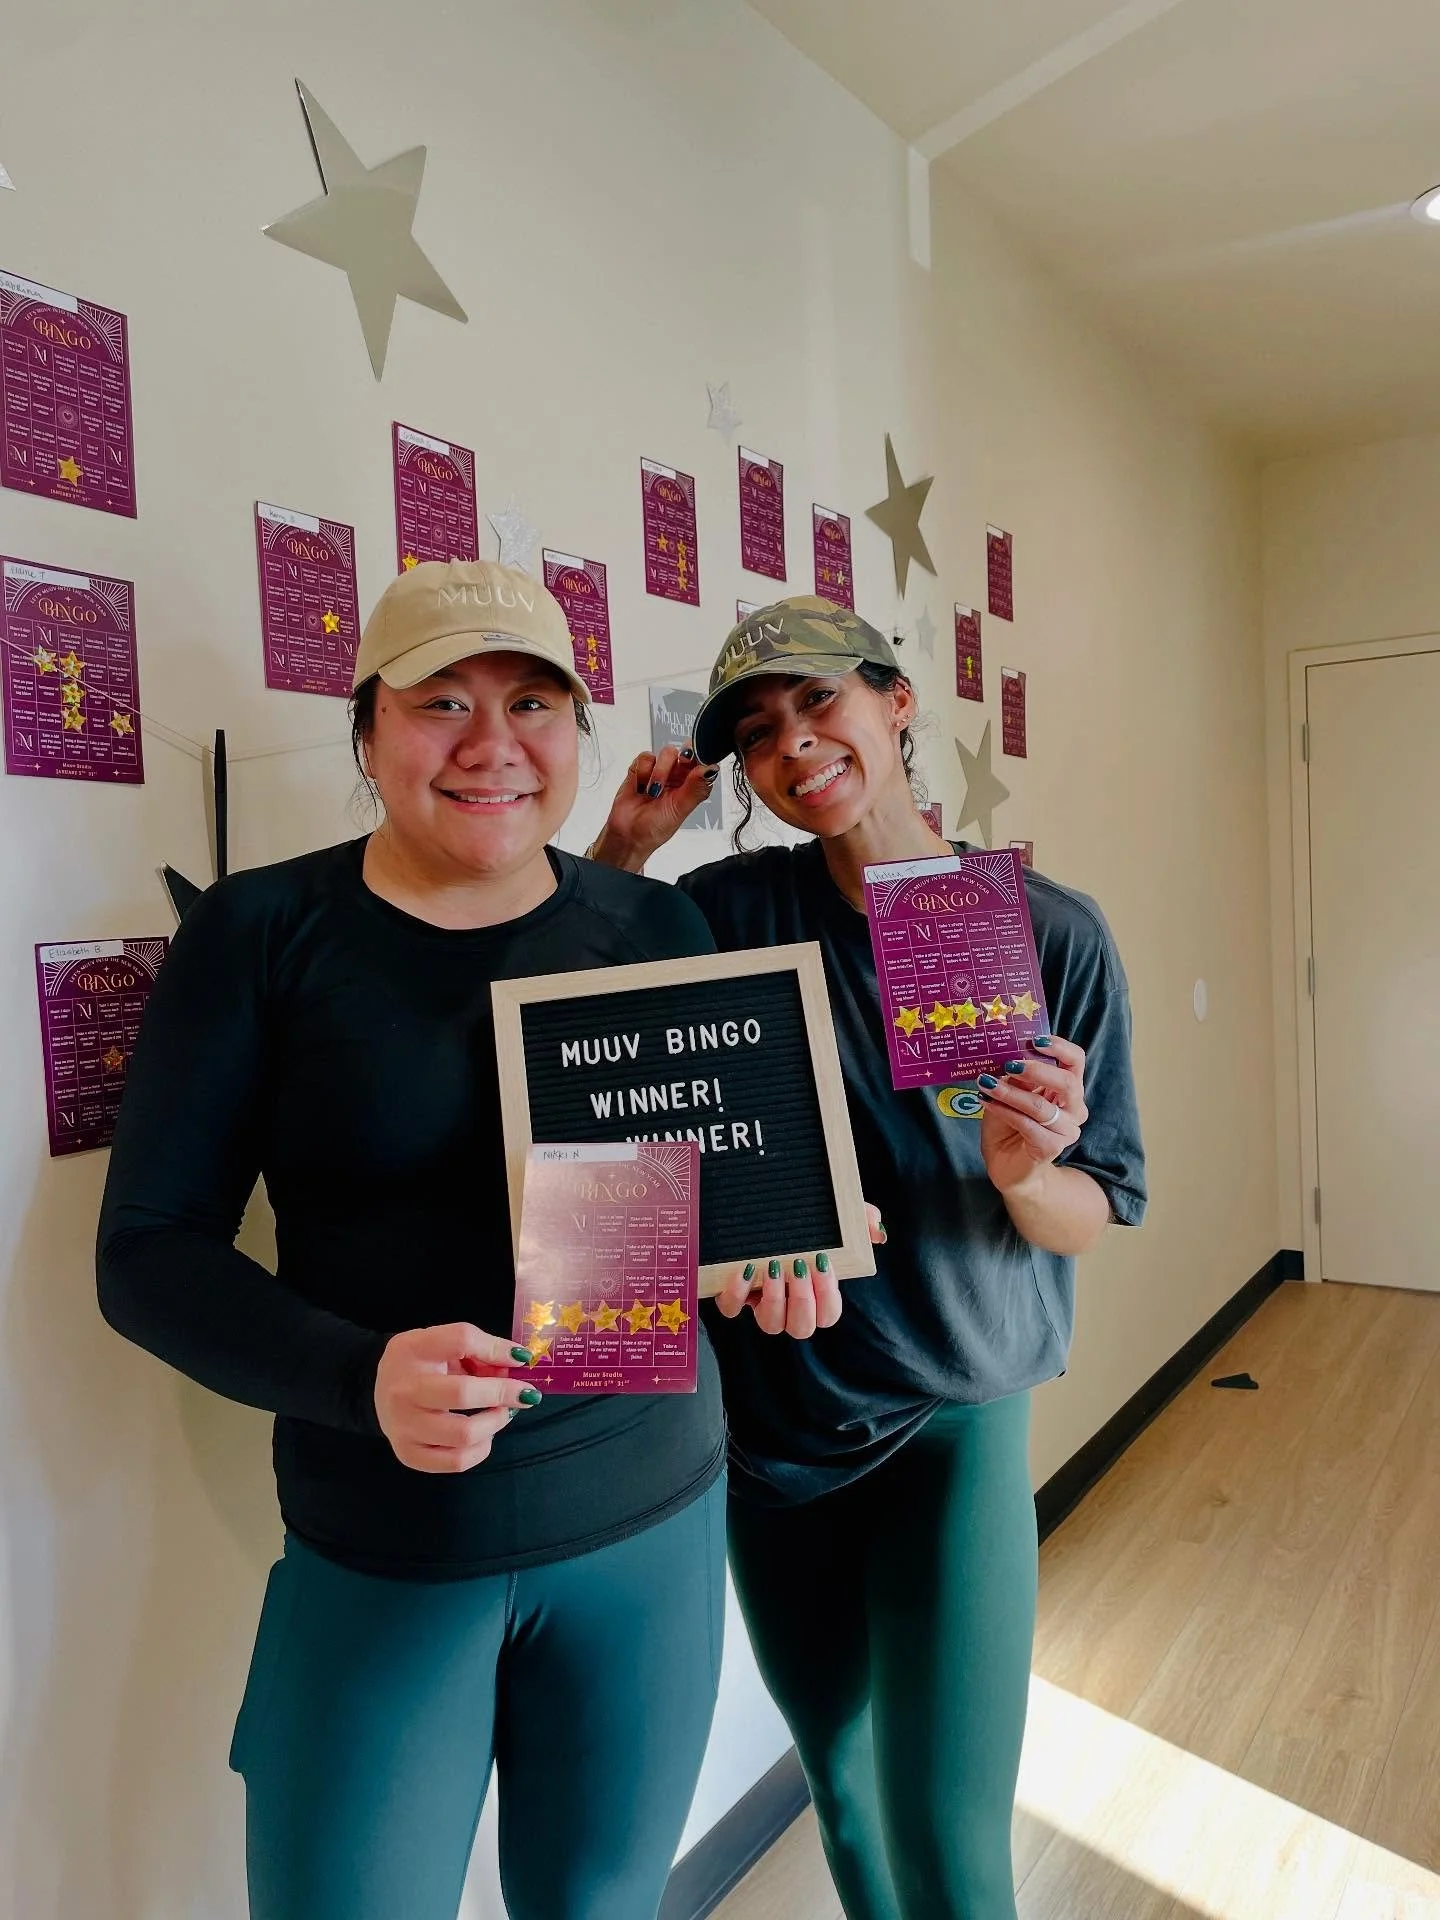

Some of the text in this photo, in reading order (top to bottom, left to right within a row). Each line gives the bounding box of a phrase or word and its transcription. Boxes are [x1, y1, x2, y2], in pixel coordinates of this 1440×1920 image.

[33, 316, 91, 349] BINGO
[417, 457, 452, 481] BINGO
[286, 537, 328, 562] BINGO
[39, 597, 97, 624] BINGO
[438, 585, 534, 613] MUUV
[717, 617, 783, 682] MUUV
[866, 866, 917, 882] Chelsea T
[902, 890, 915, 904] LET'S
[914, 879, 930, 891] MUUV
[931, 874, 947, 882] INTO
[961, 876, 975, 885] NEW
[976, 882, 990, 895] YEAR
[911, 891, 979, 913] BINGO
[48, 946, 89, 958] Elizabeth
[77, 972, 135, 993] BINGO
[561, 1018, 761, 1068] MUUV BINGO
[590, 1077, 724, 1120] WINNER!
[626, 1119, 765, 1156] NER!
[633, 1166, 646, 1175] NEW
[647, 1173, 660, 1188] YEAR
